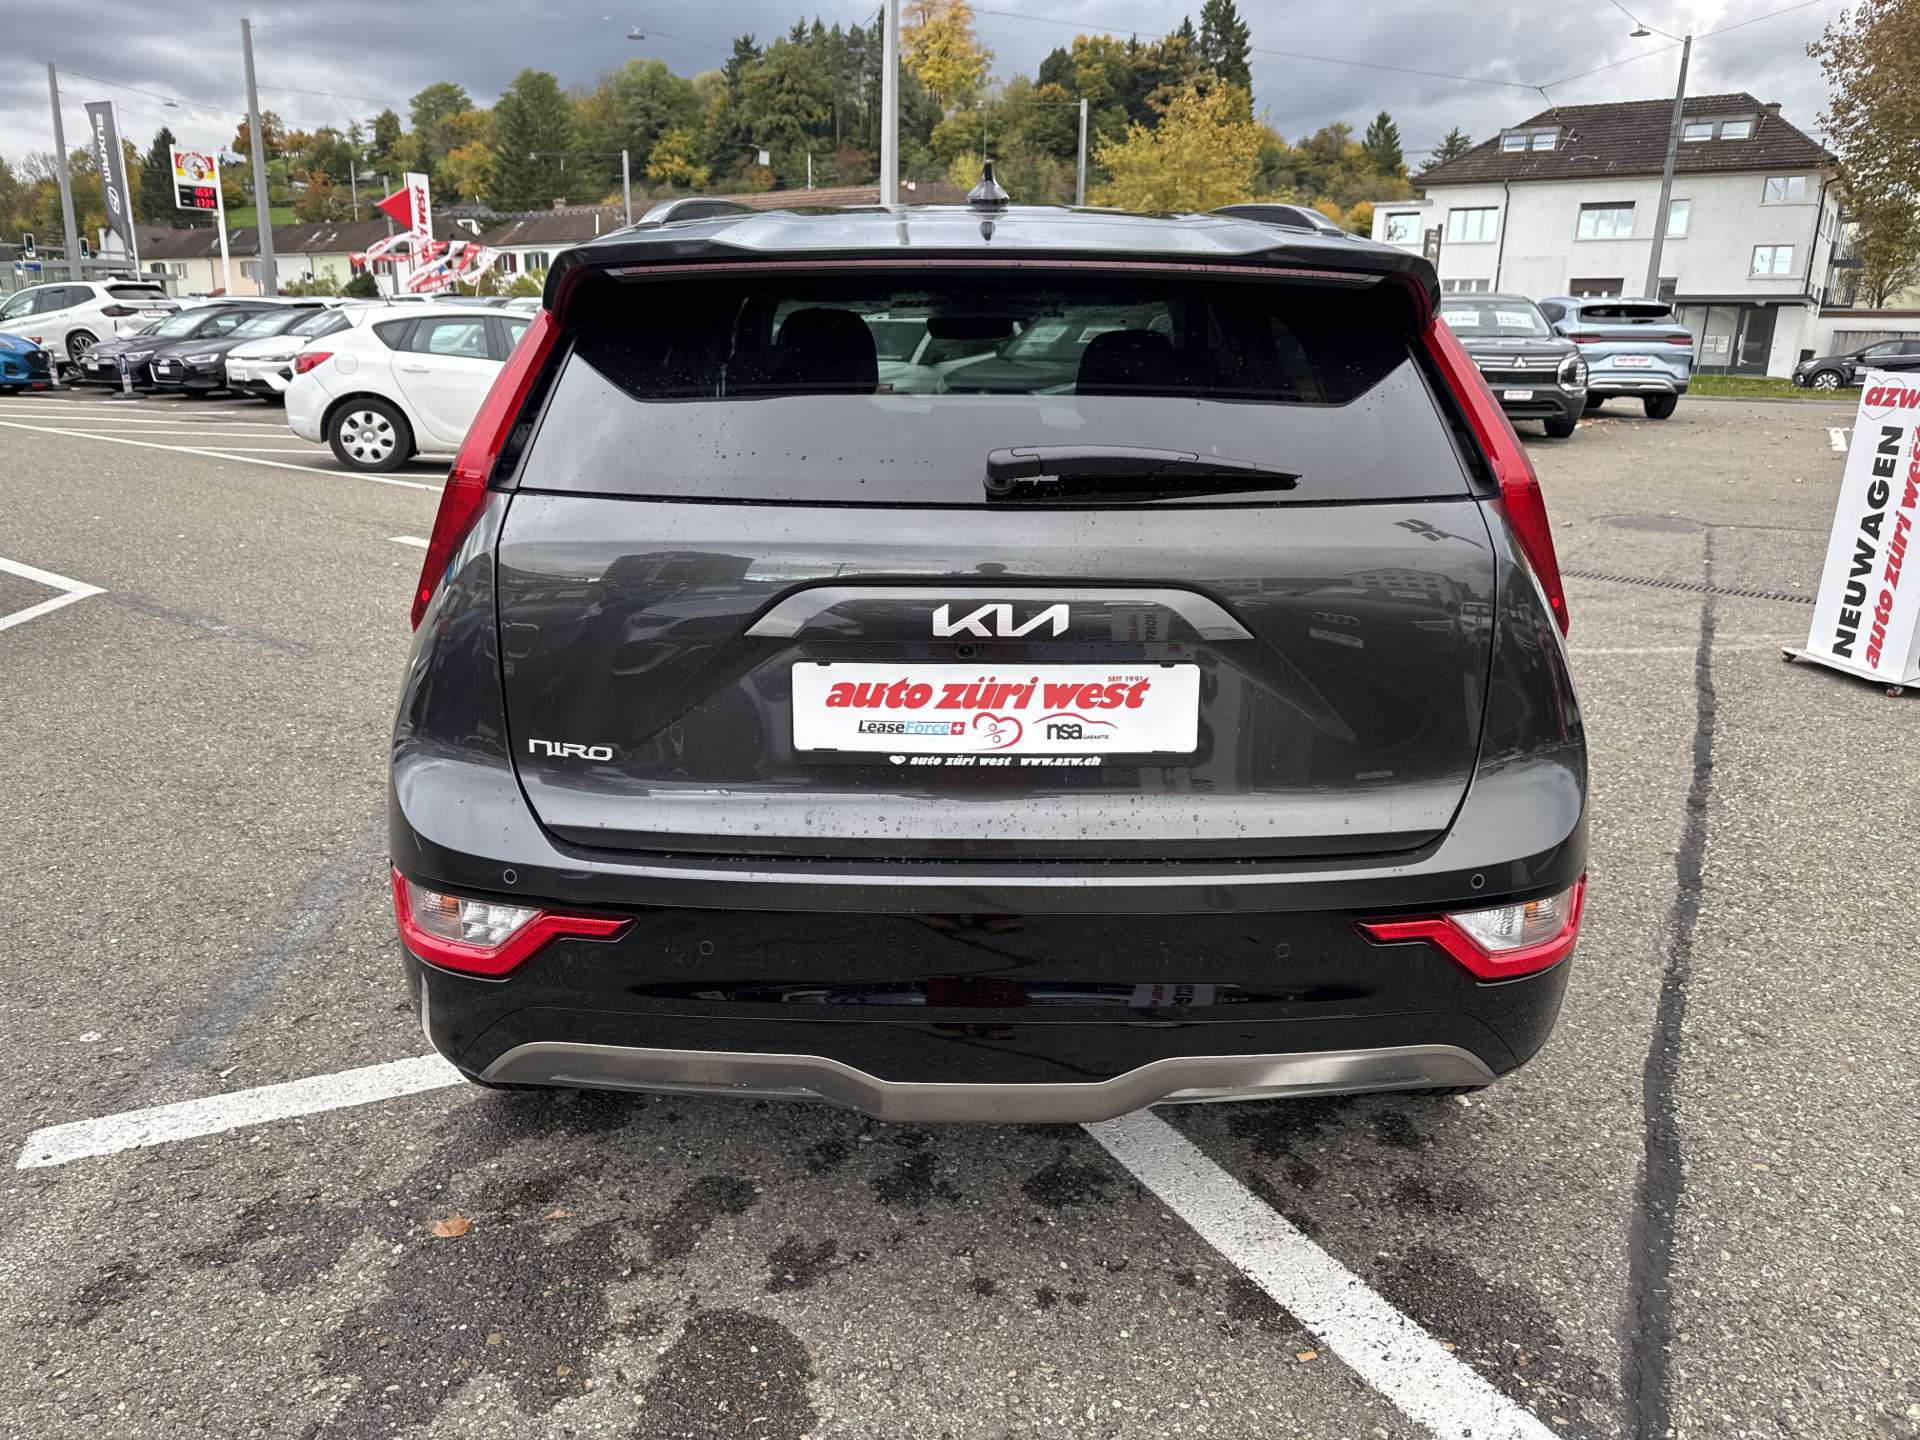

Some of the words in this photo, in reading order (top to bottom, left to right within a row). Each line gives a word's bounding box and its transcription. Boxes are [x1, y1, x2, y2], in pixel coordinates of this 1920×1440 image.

[1832, 426, 1903, 658] NEUWAGEN
[1866, 589, 1893, 669] auto
[1884, 510, 1912, 591] züri
[932, 603, 1070, 638] KIA
[825, 677, 933, 709] auto
[933, 676, 1039, 709] züri
[1043, 677, 1150, 709] west
[858, 719, 950, 735] LeaseForce
[1047, 723, 1083, 740] nsa
[528, 738, 613, 761] NIRO
[910, 755, 942, 766] auto
[945, 755, 976, 766] züri
[979, 755, 1012, 766] west
[1020, 755, 1102, 767] www.azw.ch
